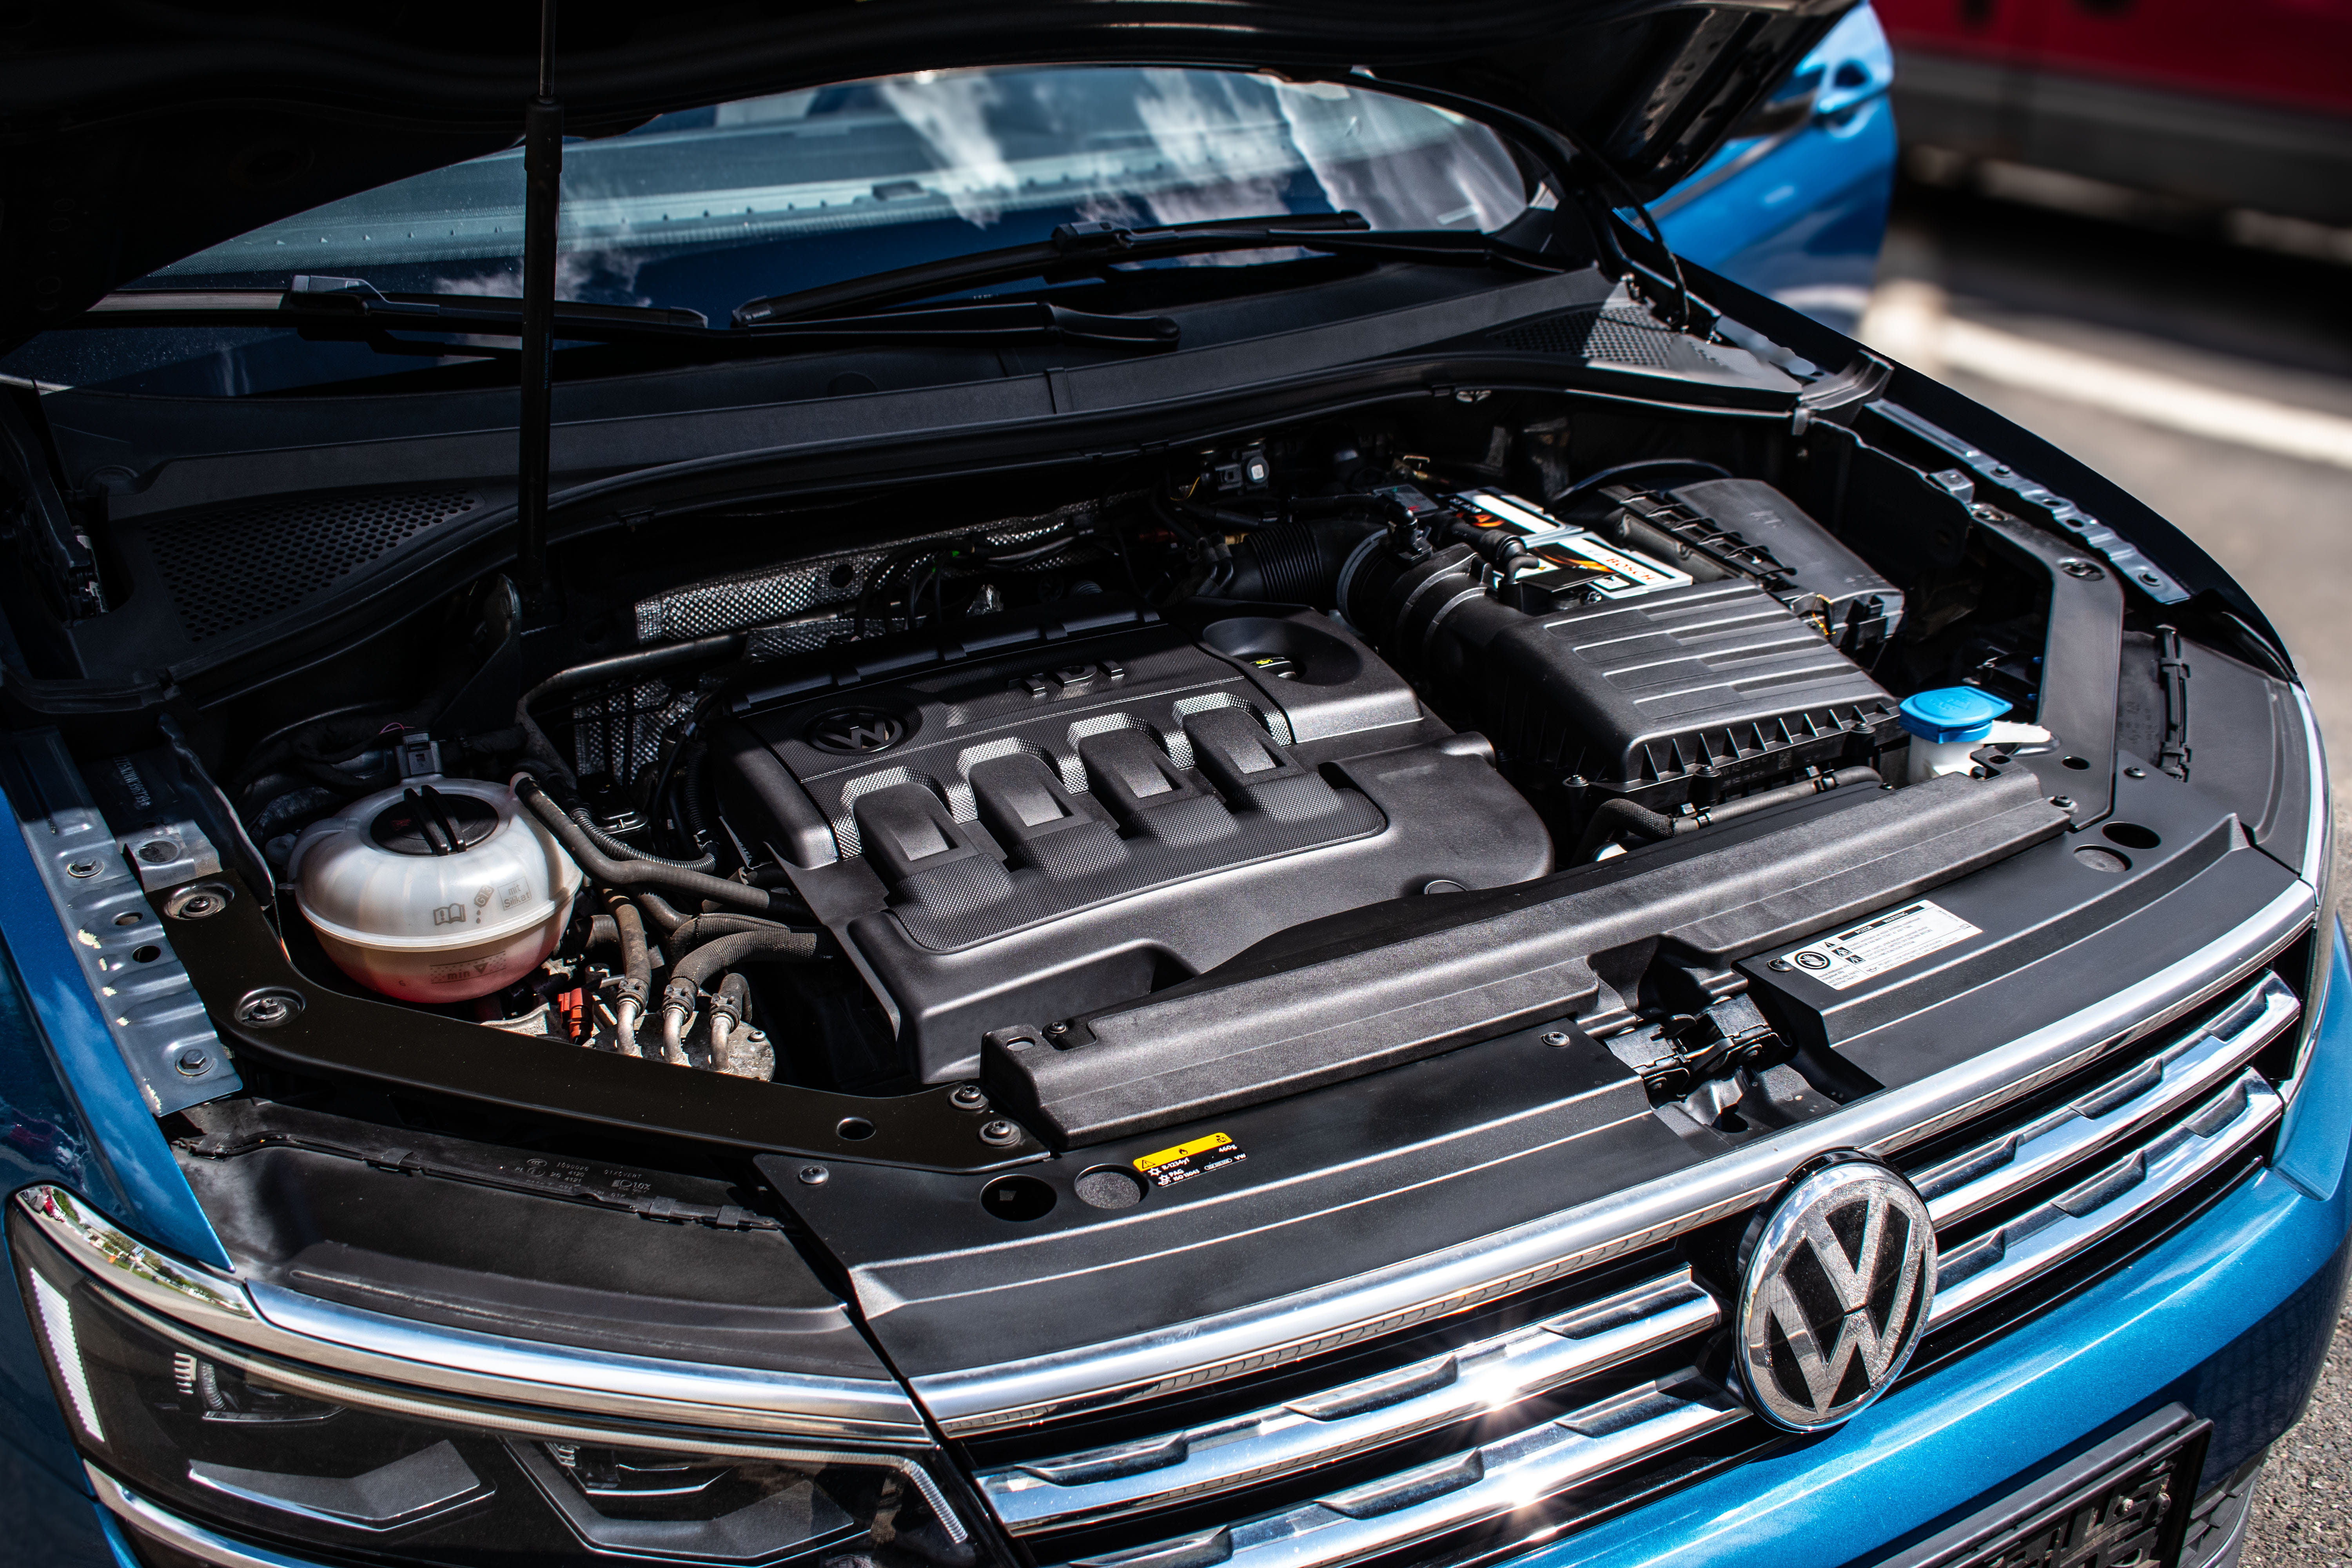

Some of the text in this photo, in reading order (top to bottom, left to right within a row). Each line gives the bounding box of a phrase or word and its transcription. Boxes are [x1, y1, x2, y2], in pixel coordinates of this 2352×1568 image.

[1008, 660, 1125, 696] TDI
[476, 886, 492, 905] G13
[508, 884, 521, 895] mit
[504, 892, 530, 908] Silikat
[1854, 911, 1909, 934] POZOR WARNING
[447, 971, 470, 980] min
[1218, 1144, 1237, 1153] 460g
[1169, 1168, 1184, 1178] PAG
[1746, 1174, 1935, 1421] VW
